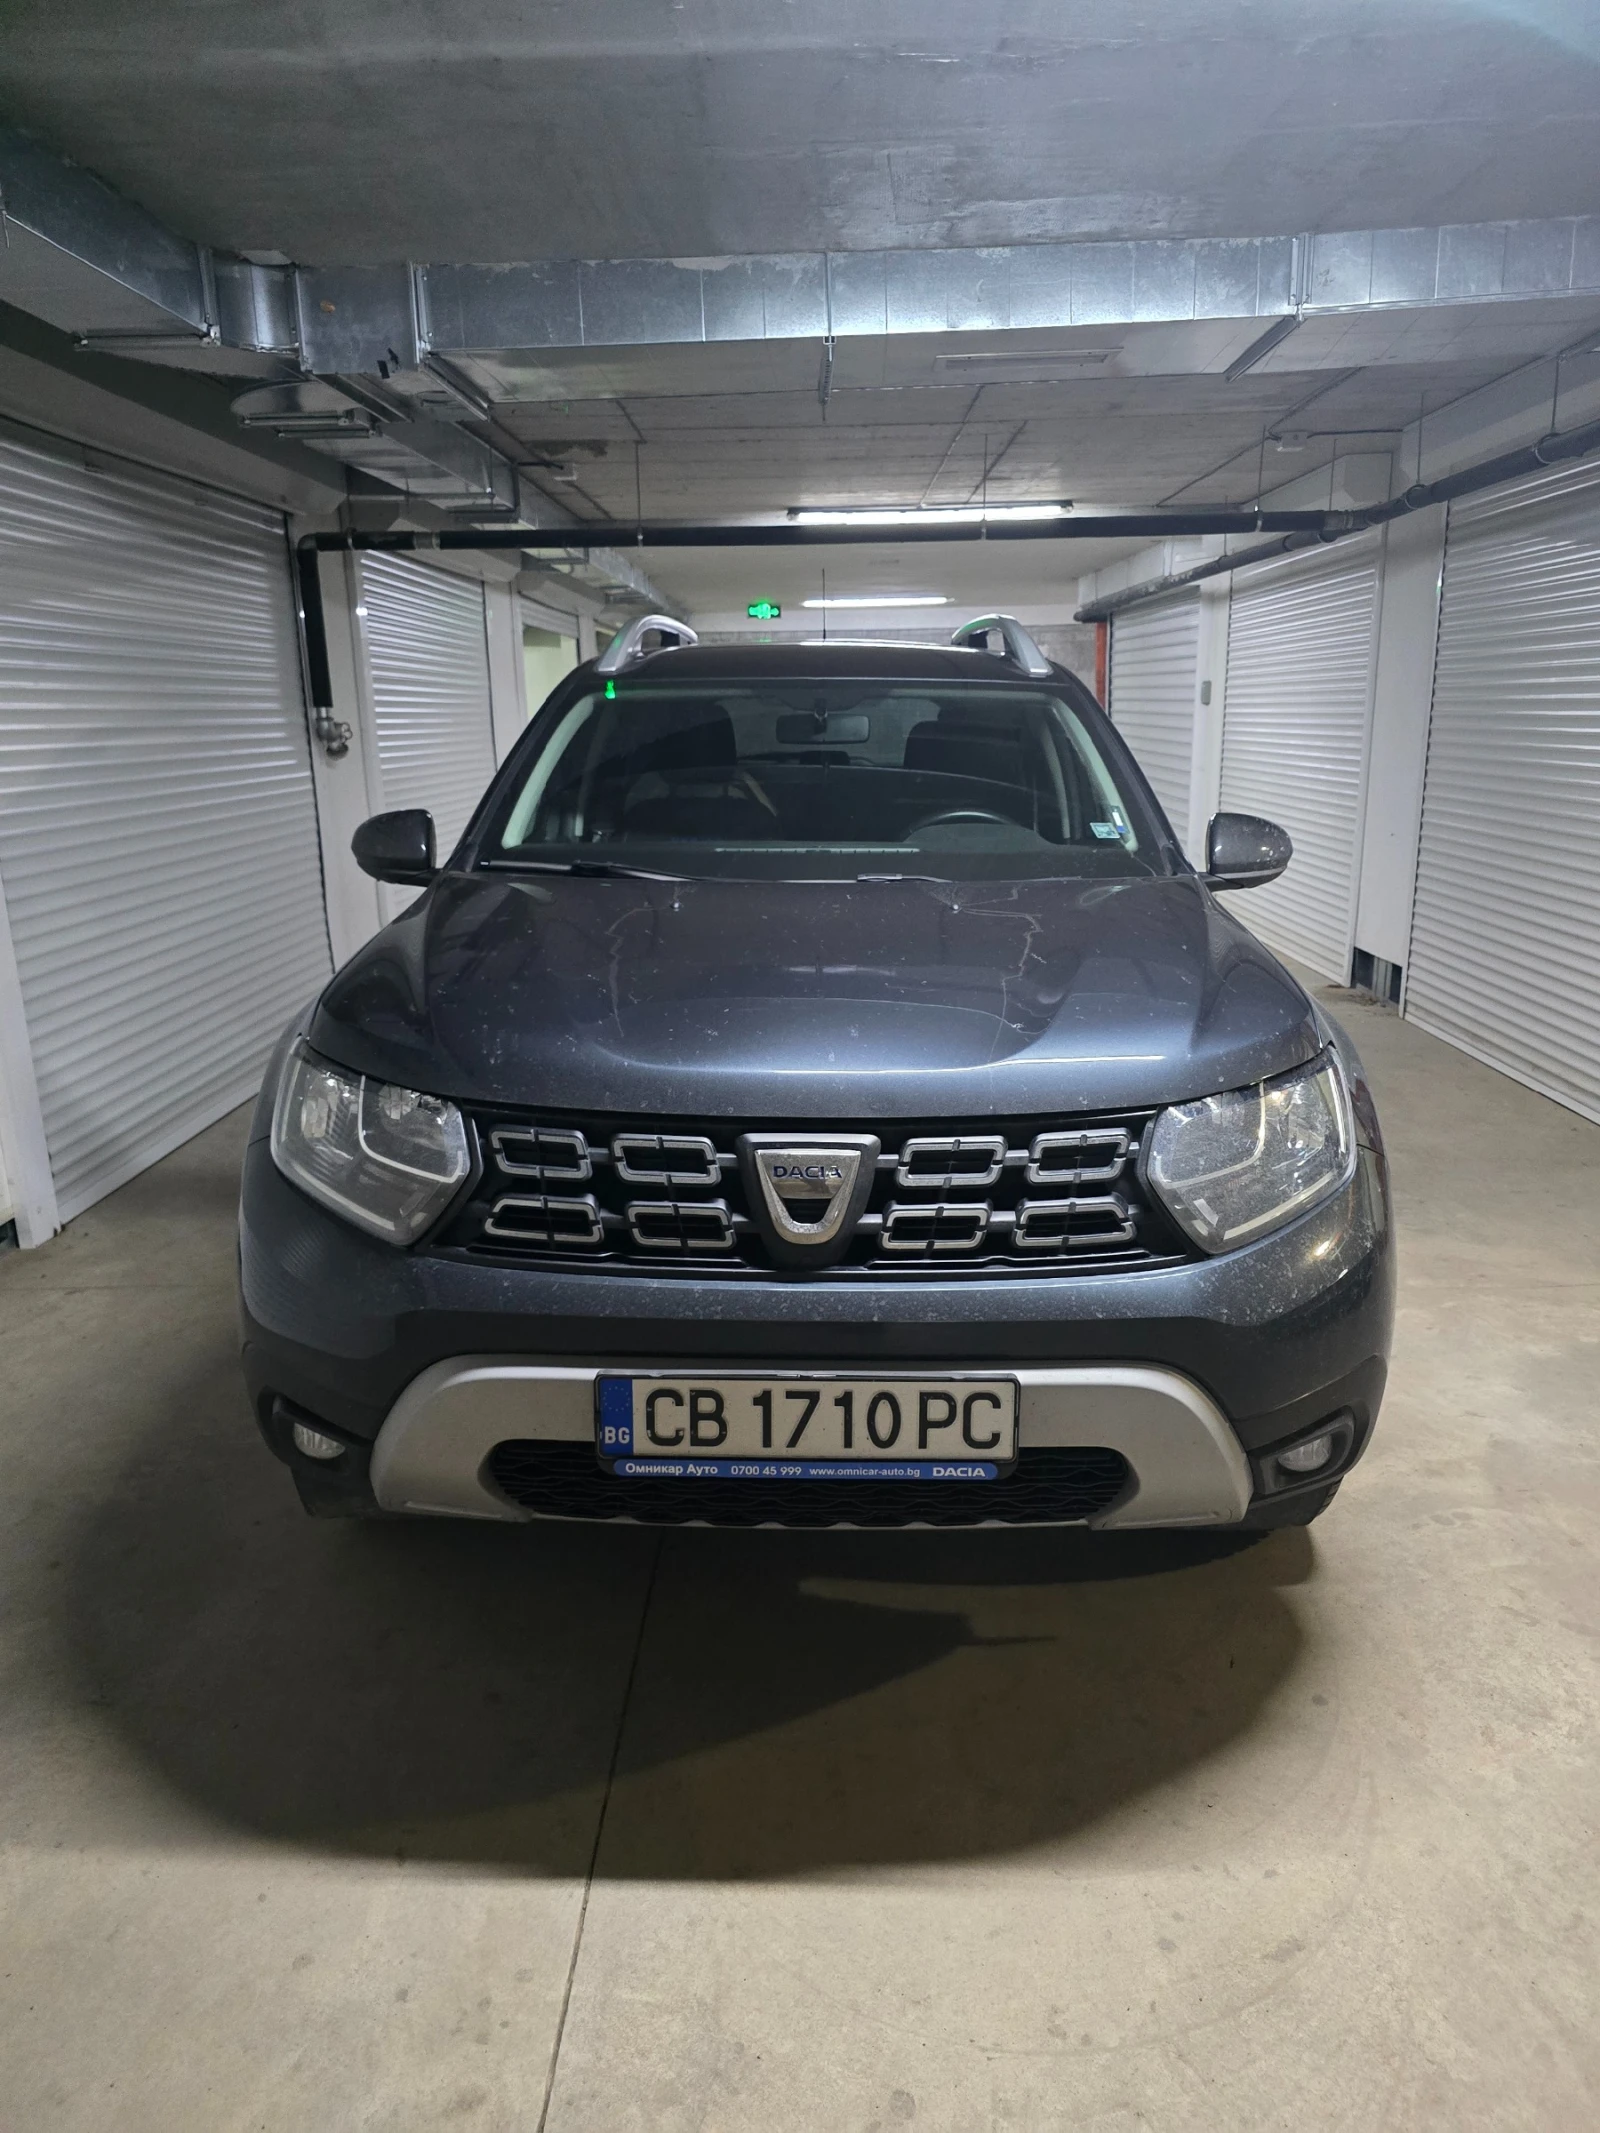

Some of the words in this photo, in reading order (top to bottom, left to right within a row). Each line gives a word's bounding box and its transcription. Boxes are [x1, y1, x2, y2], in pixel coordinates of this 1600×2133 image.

[773, 1165, 842, 1179] DACIA
[645, 1387, 729, 1447] CB
[752, 1388, 902, 1449] 1710
[918, 1390, 1002, 1450] PC
[604, 1426, 630, 1444] BG
[625, 1463, 683, 1475] Омникар
[687, 1464, 718, 1476] Ауто
[731, 1466, 760, 1476] 0700
[763, 1466, 777, 1476] 45
[780, 1466, 802, 1476] 999
[809, 1467, 920, 1477] www.omnicar-auto.bg
[933, 1467, 986, 1477] DACIA
